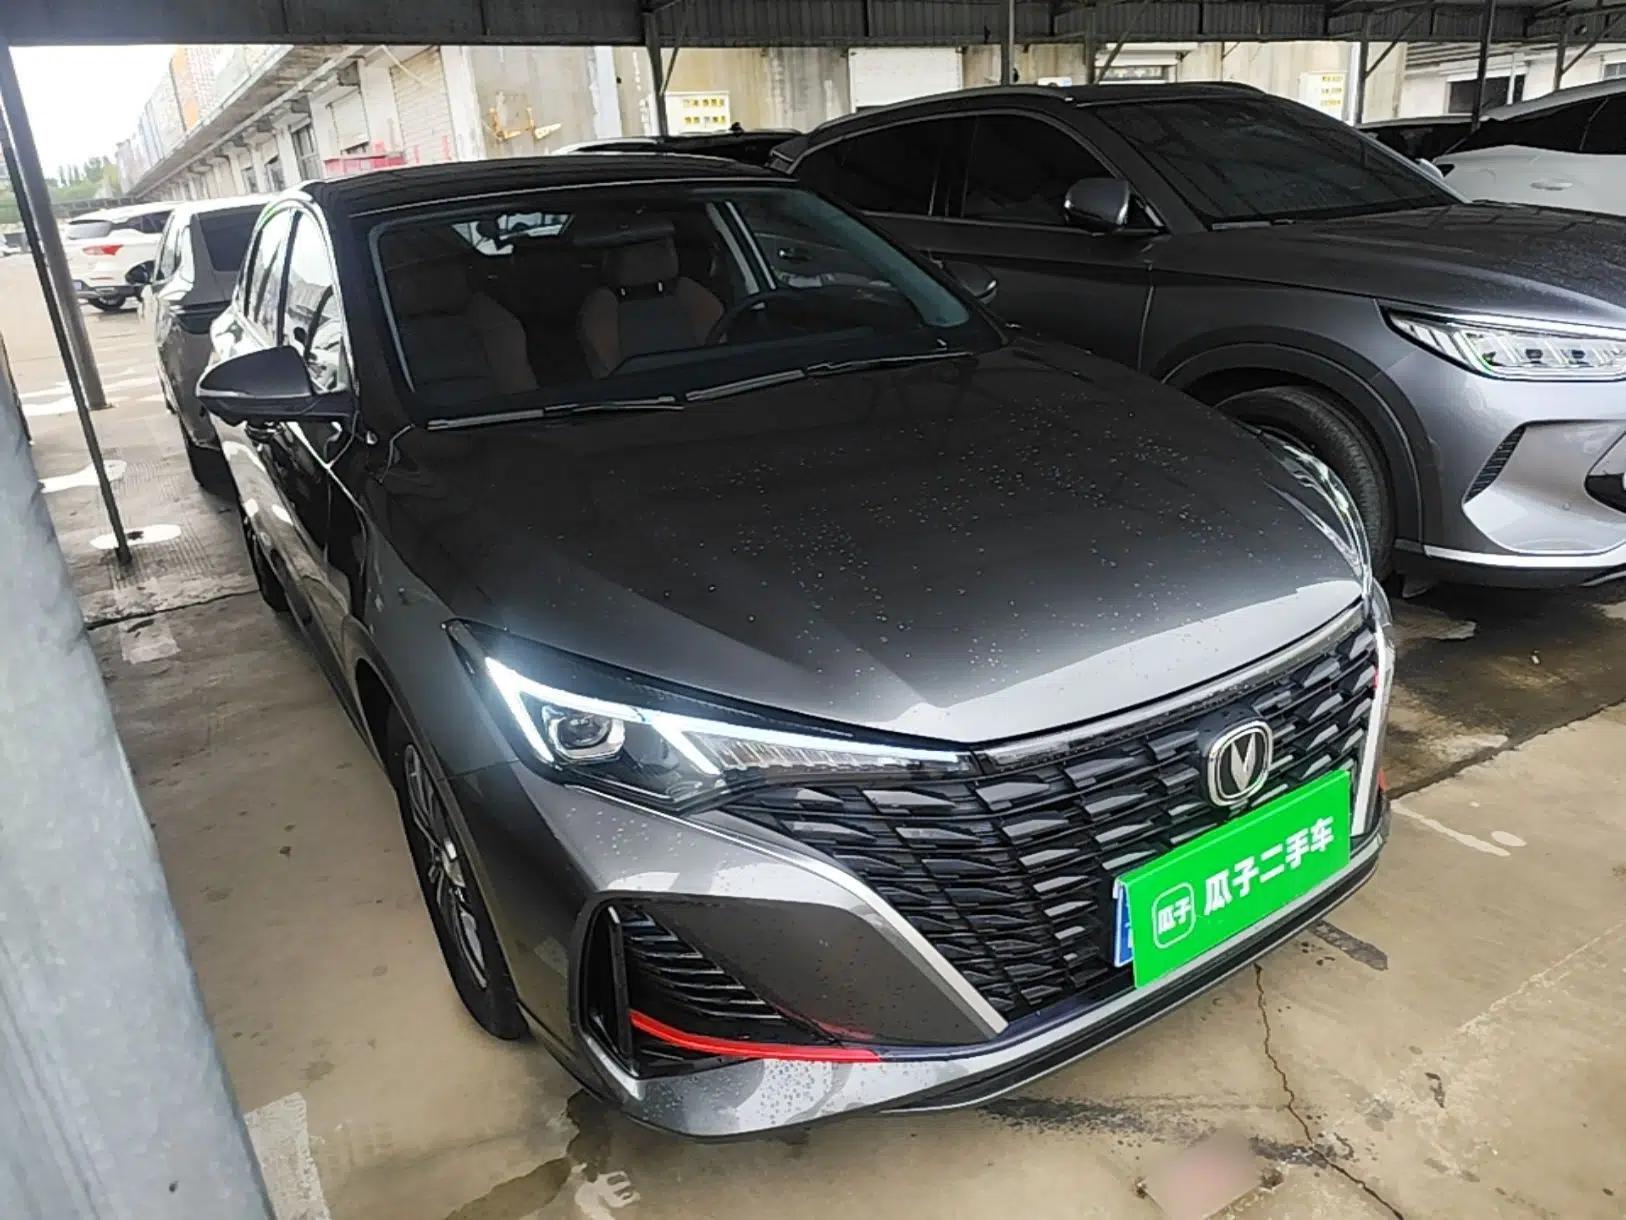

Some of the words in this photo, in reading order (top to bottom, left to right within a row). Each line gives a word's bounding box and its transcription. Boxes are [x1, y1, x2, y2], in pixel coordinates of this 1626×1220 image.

[1204, 816, 1334, 915] 瓜子二手车
[1157, 896, 1192, 934] 瓜子
